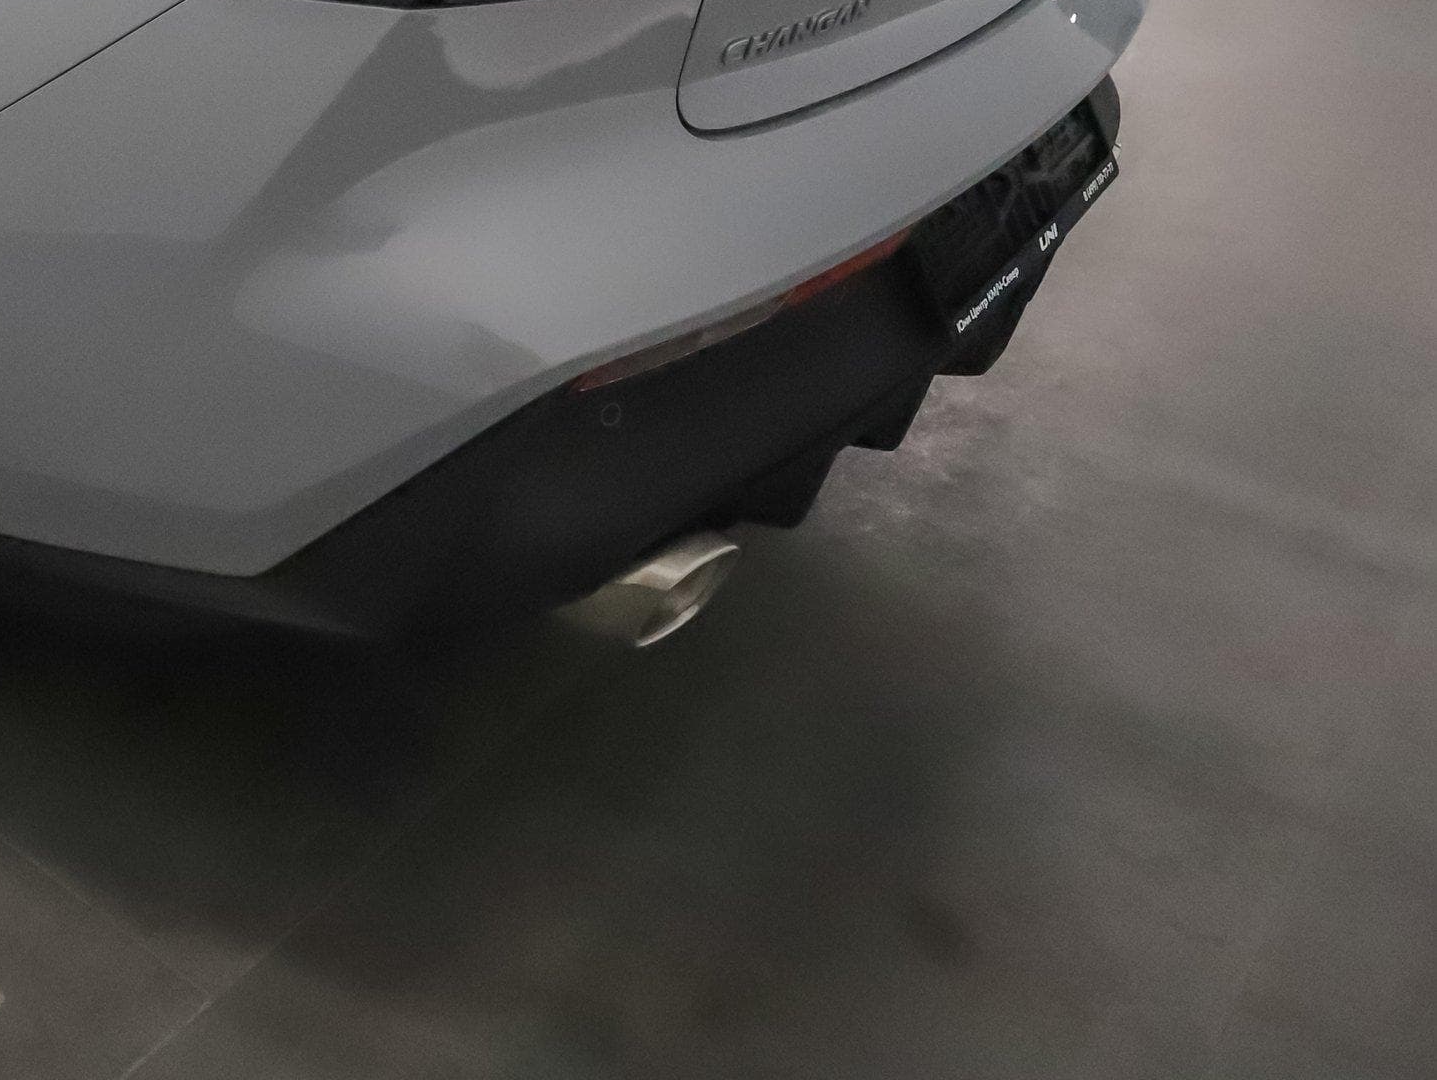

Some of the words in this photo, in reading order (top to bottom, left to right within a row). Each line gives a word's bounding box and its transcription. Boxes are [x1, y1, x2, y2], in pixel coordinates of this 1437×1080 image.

[1038, 222, 1058, 252] UNI
[956, 315, 972, 334] Юни
[969, 297, 989, 320] Центр
